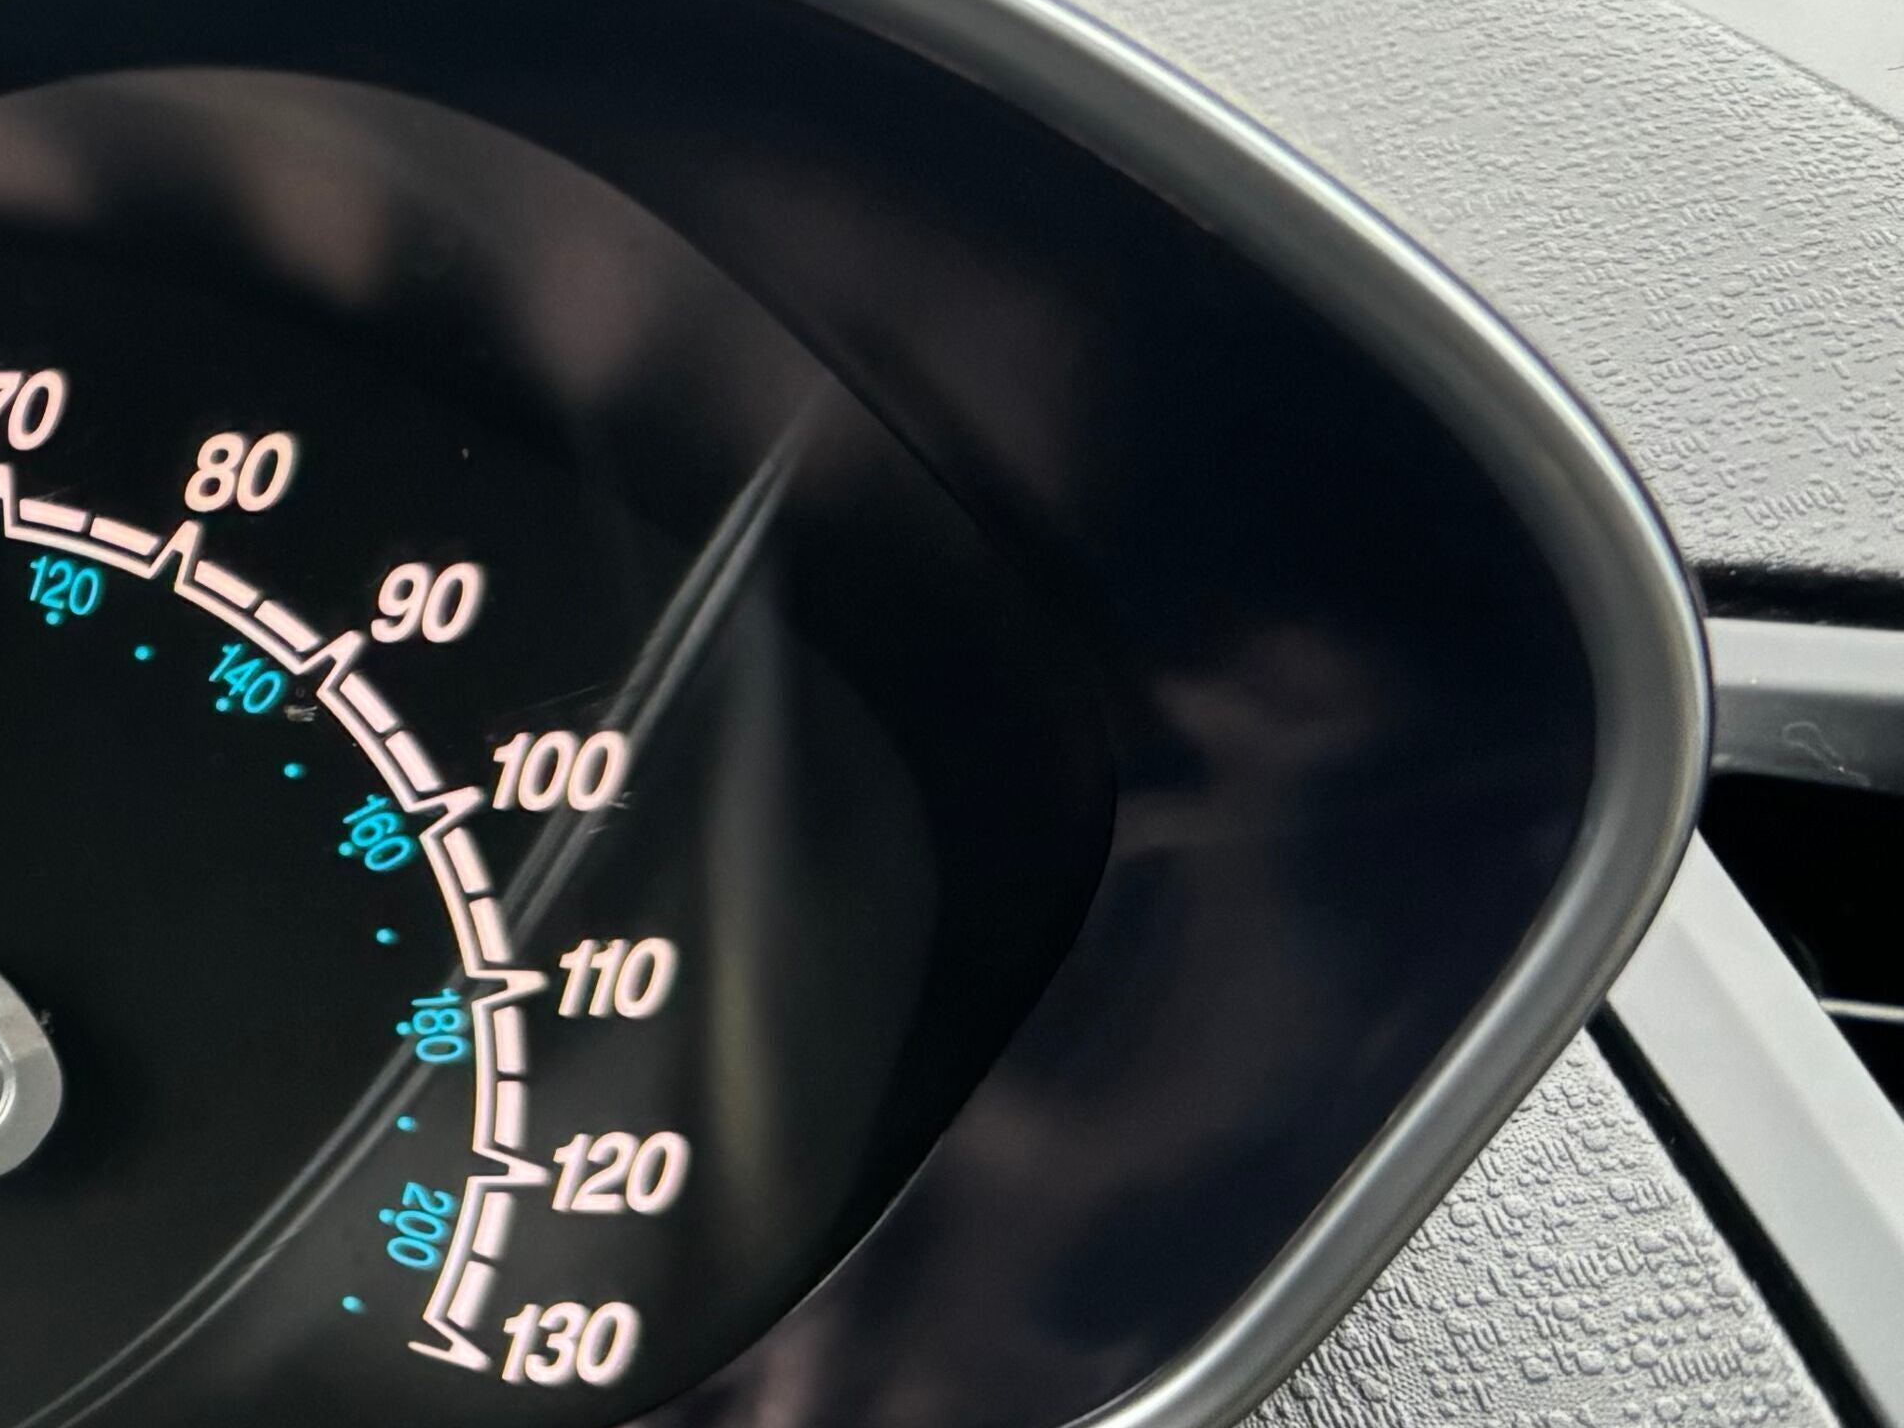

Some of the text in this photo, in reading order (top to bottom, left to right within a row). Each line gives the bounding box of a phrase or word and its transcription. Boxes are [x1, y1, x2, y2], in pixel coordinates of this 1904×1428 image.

[185, 432, 296, 513] 80
[28, 555, 102, 616] 120
[370, 562, 484, 643] 90
[208, 642, 284, 715] 140
[493, 731, 626, 812] 100
[342, 793, 415, 872] 160
[558, 937, 678, 1019] 110
[411, 988, 472, 1063] 180
[552, 1131, 691, 1214] 120
[386, 1181, 457, 1270] 200
[501, 1301, 642, 1387] 130
